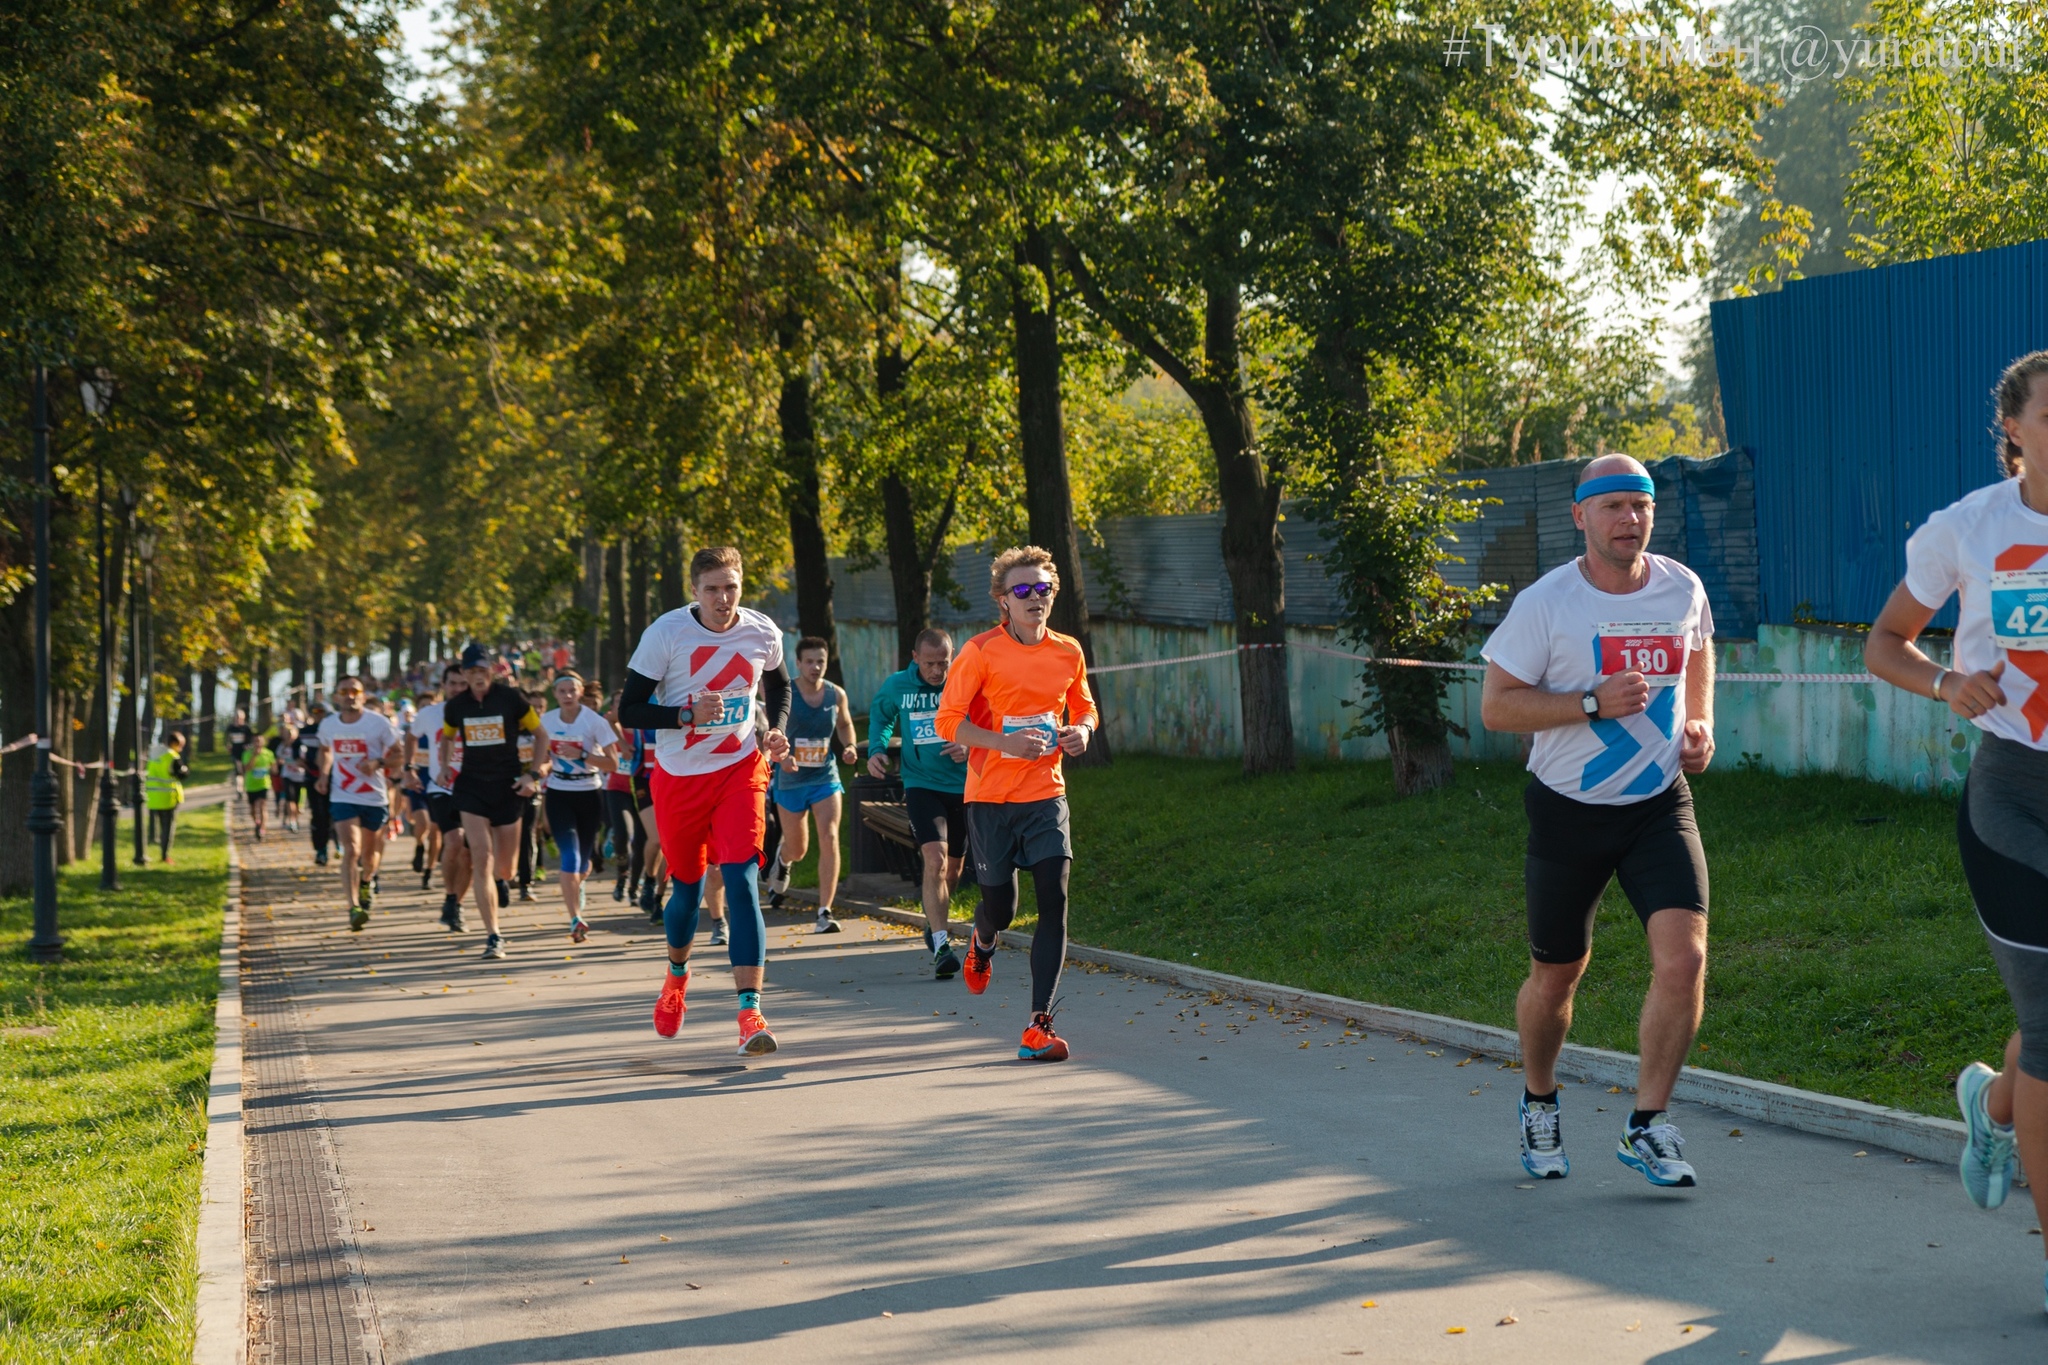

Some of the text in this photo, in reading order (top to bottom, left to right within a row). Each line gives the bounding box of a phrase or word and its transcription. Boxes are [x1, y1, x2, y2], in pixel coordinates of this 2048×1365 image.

[1620, 648, 1668, 673] 180
[901, 692, 928, 709] JUST
[469, 729, 500, 740] 1622
[915, 724, 938, 738] 26
